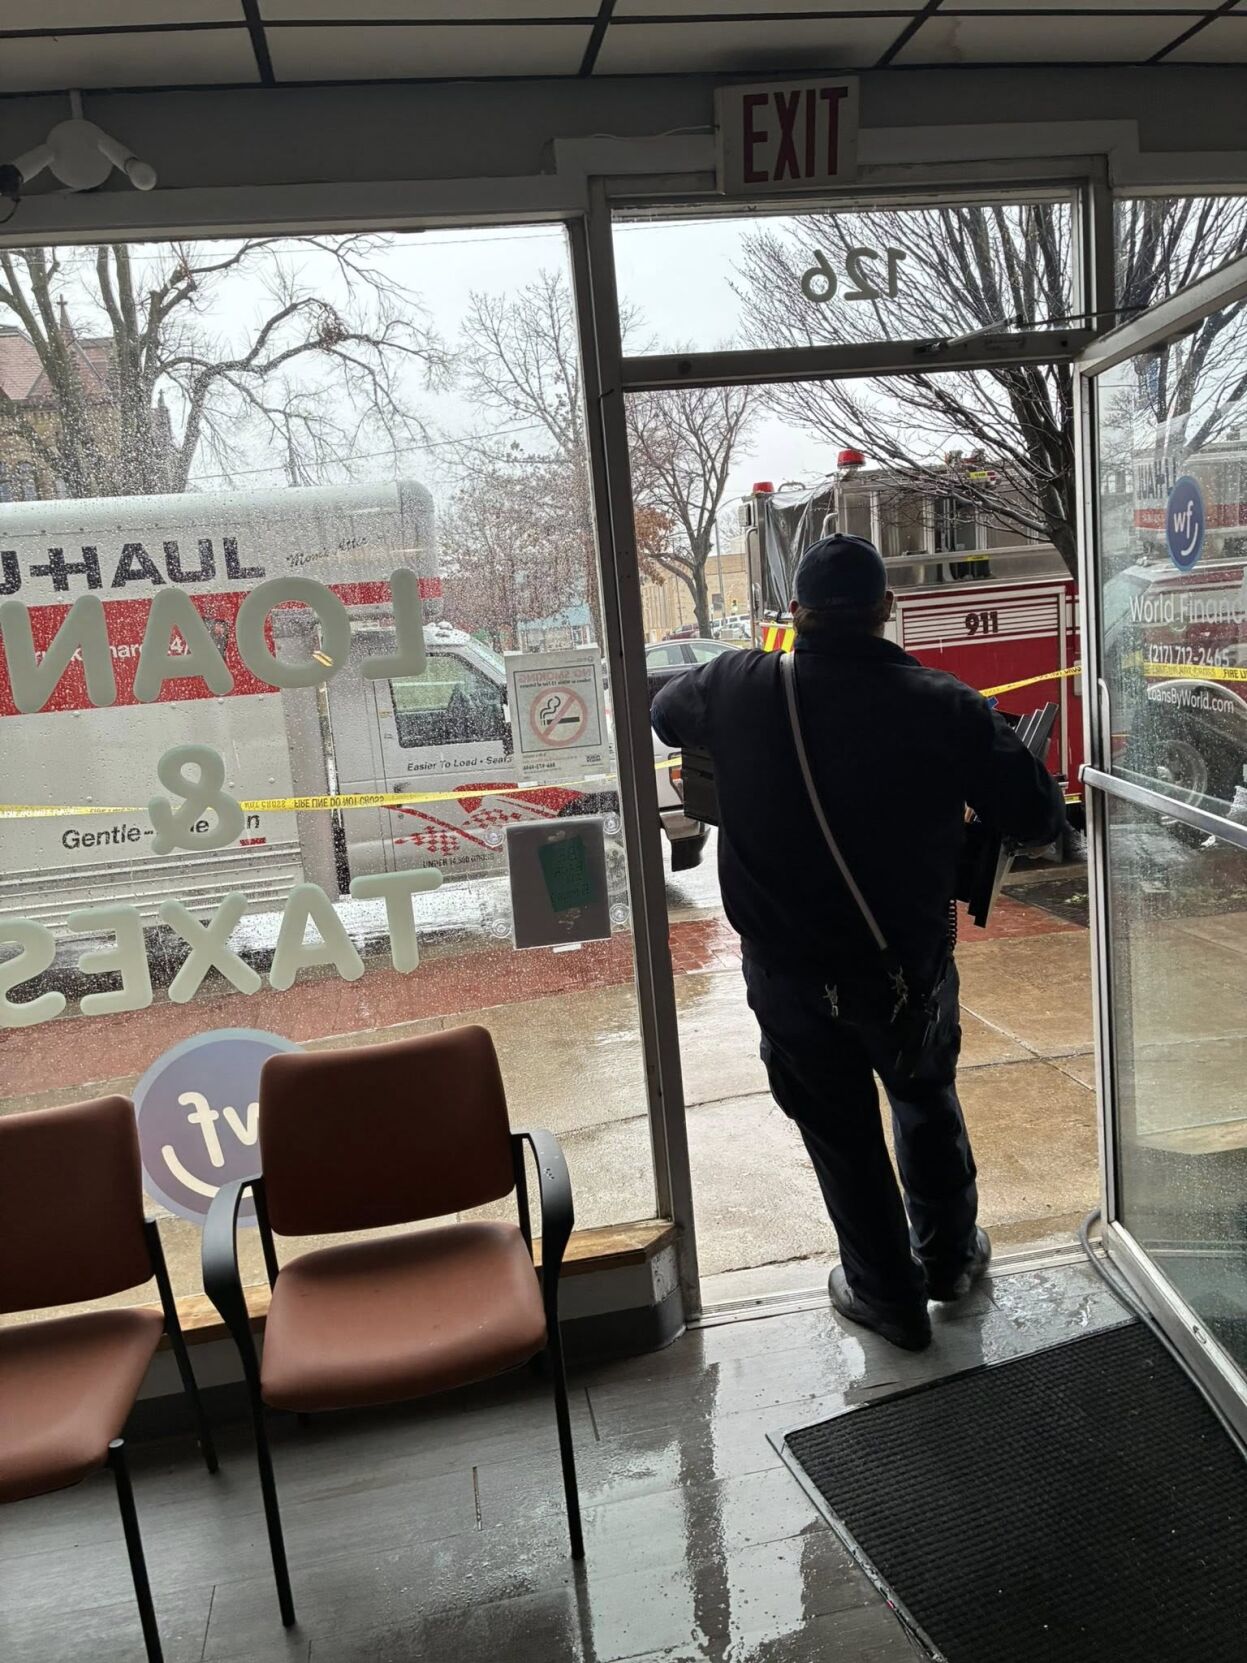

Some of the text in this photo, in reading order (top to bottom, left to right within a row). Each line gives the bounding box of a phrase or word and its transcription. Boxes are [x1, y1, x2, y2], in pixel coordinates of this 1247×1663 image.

[742, 86, 849, 184] EXIT
[1173, 500, 1194, 540] wf
[965, 611, 999, 635] 911
[1129, 594, 1174, 623] World
[1149, 643, 1230, 667] (217) 712-2465
[1147, 684, 1235, 713] LoansByWorld.com
[407, 762, 437, 771] Easier
[440, 760, 451, 769] To
[453, 758, 478, 768] Load
